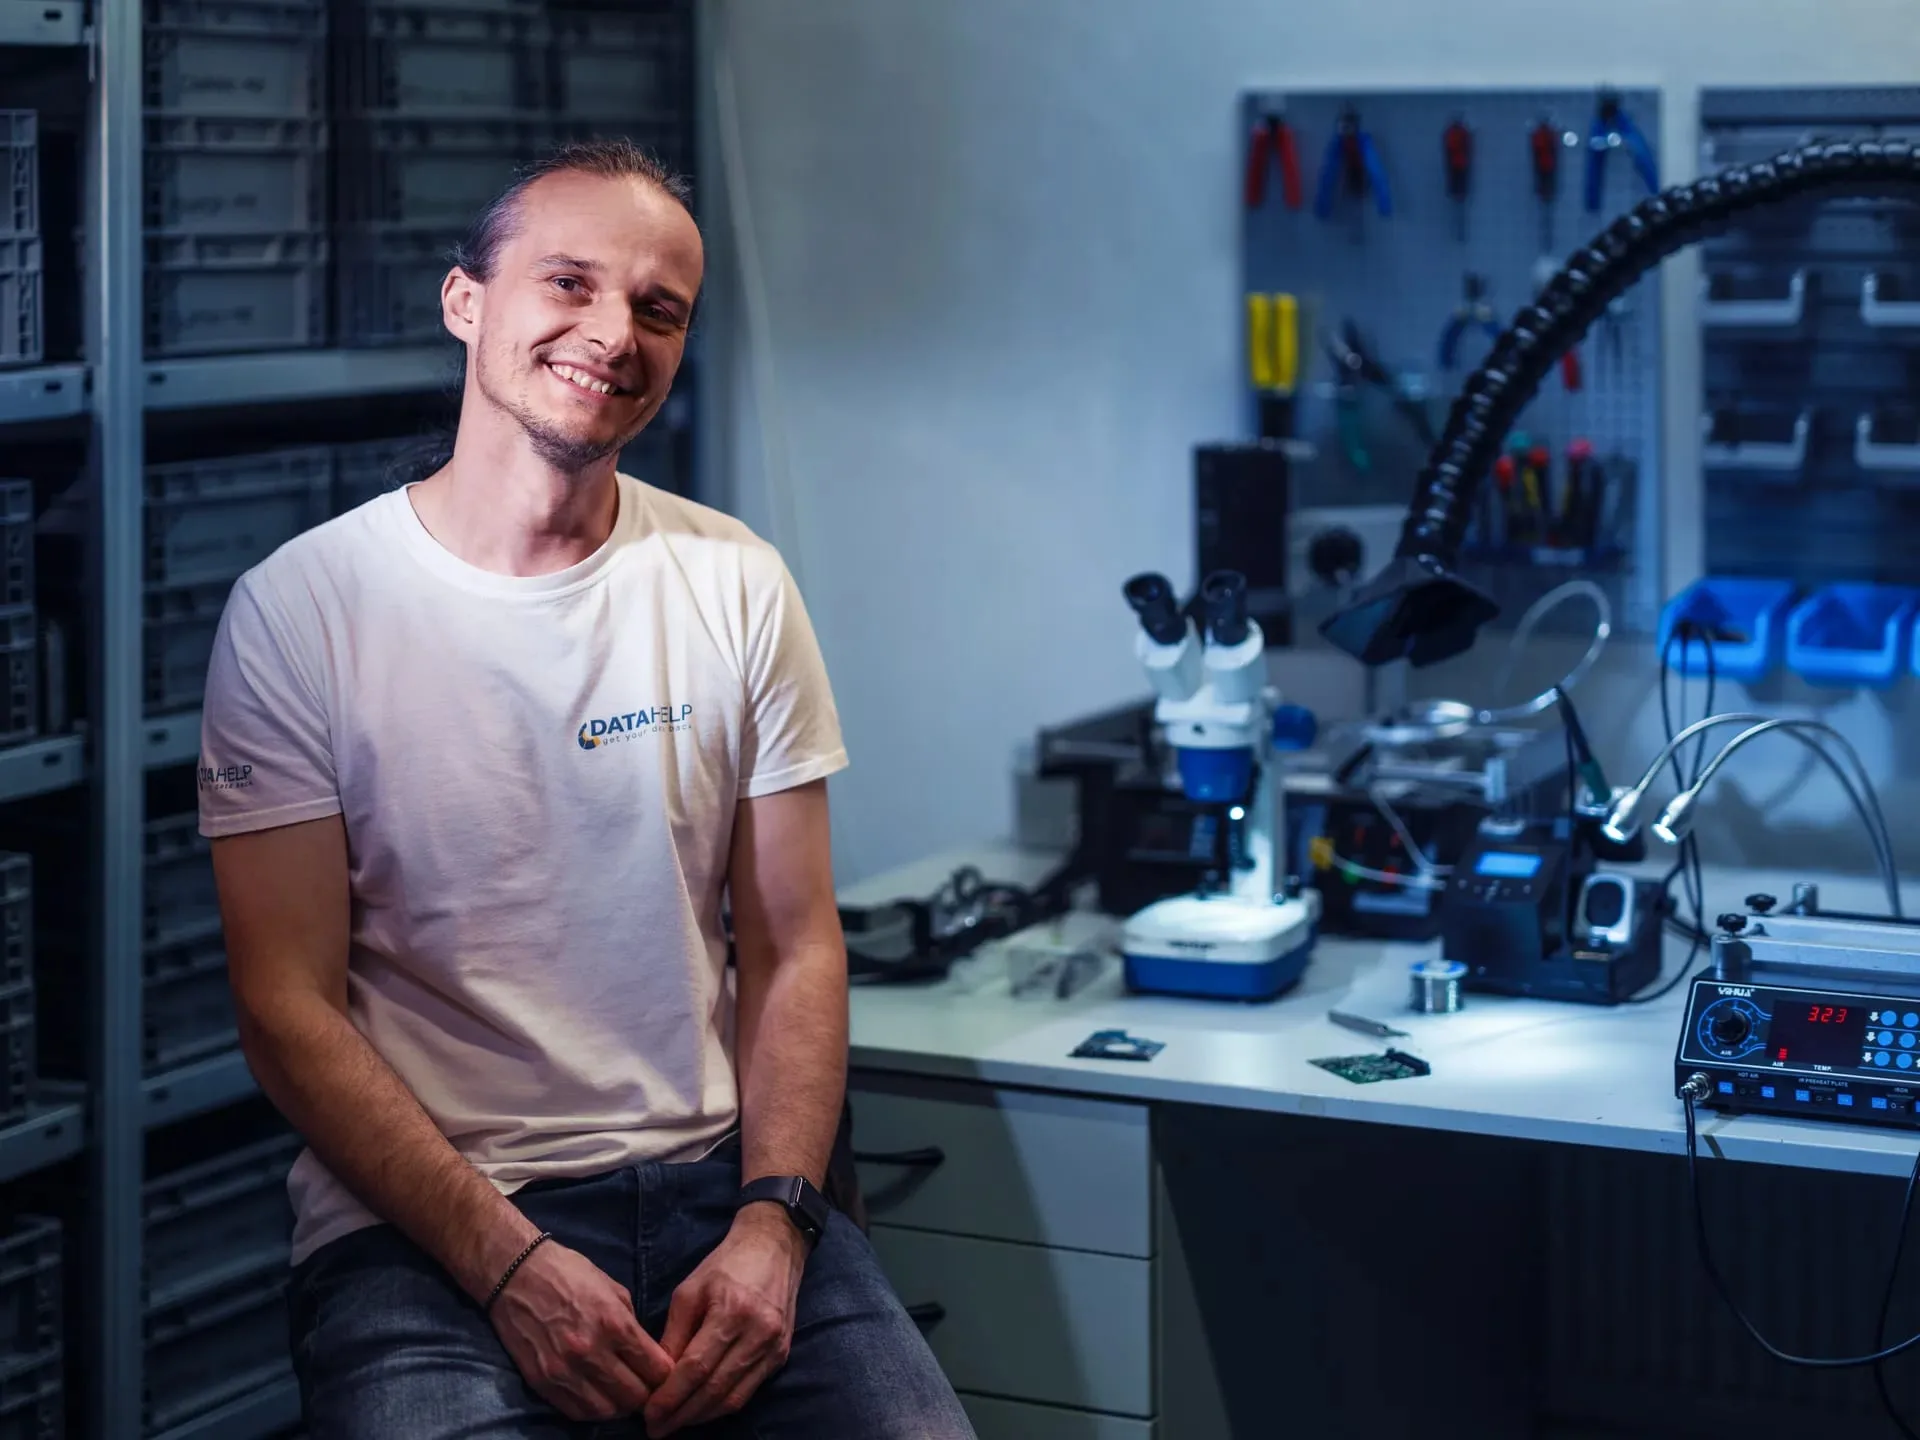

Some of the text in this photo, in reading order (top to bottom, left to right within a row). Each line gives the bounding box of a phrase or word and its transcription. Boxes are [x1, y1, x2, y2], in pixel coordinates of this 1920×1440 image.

[590, 704, 693, 737] DATAHELP
[602, 735, 621, 746] get
[625, 729, 647, 742] your
[1808, 1006, 1848, 1023] 323
